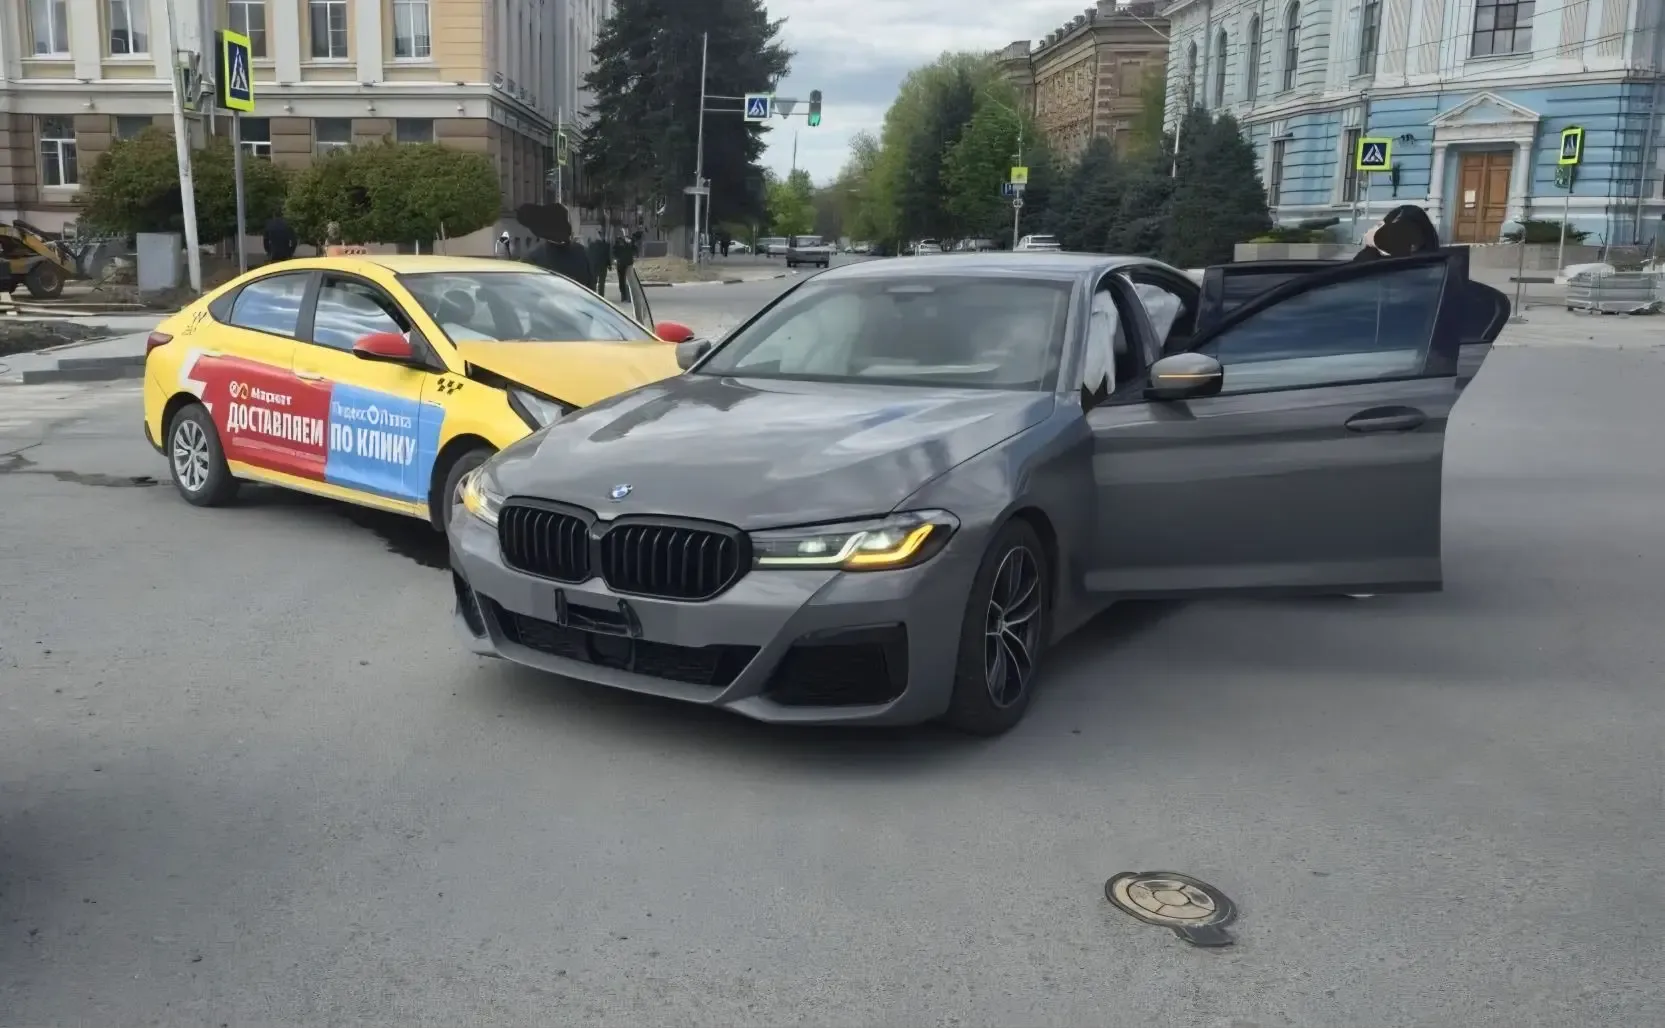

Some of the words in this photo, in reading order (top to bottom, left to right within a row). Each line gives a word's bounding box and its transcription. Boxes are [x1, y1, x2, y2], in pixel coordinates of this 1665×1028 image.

[227, 402, 324, 447] ДОСТАВЛЯЕМ
[331, 423, 353, 453] ПО
[357, 427, 416, 466] КЛИКУ
